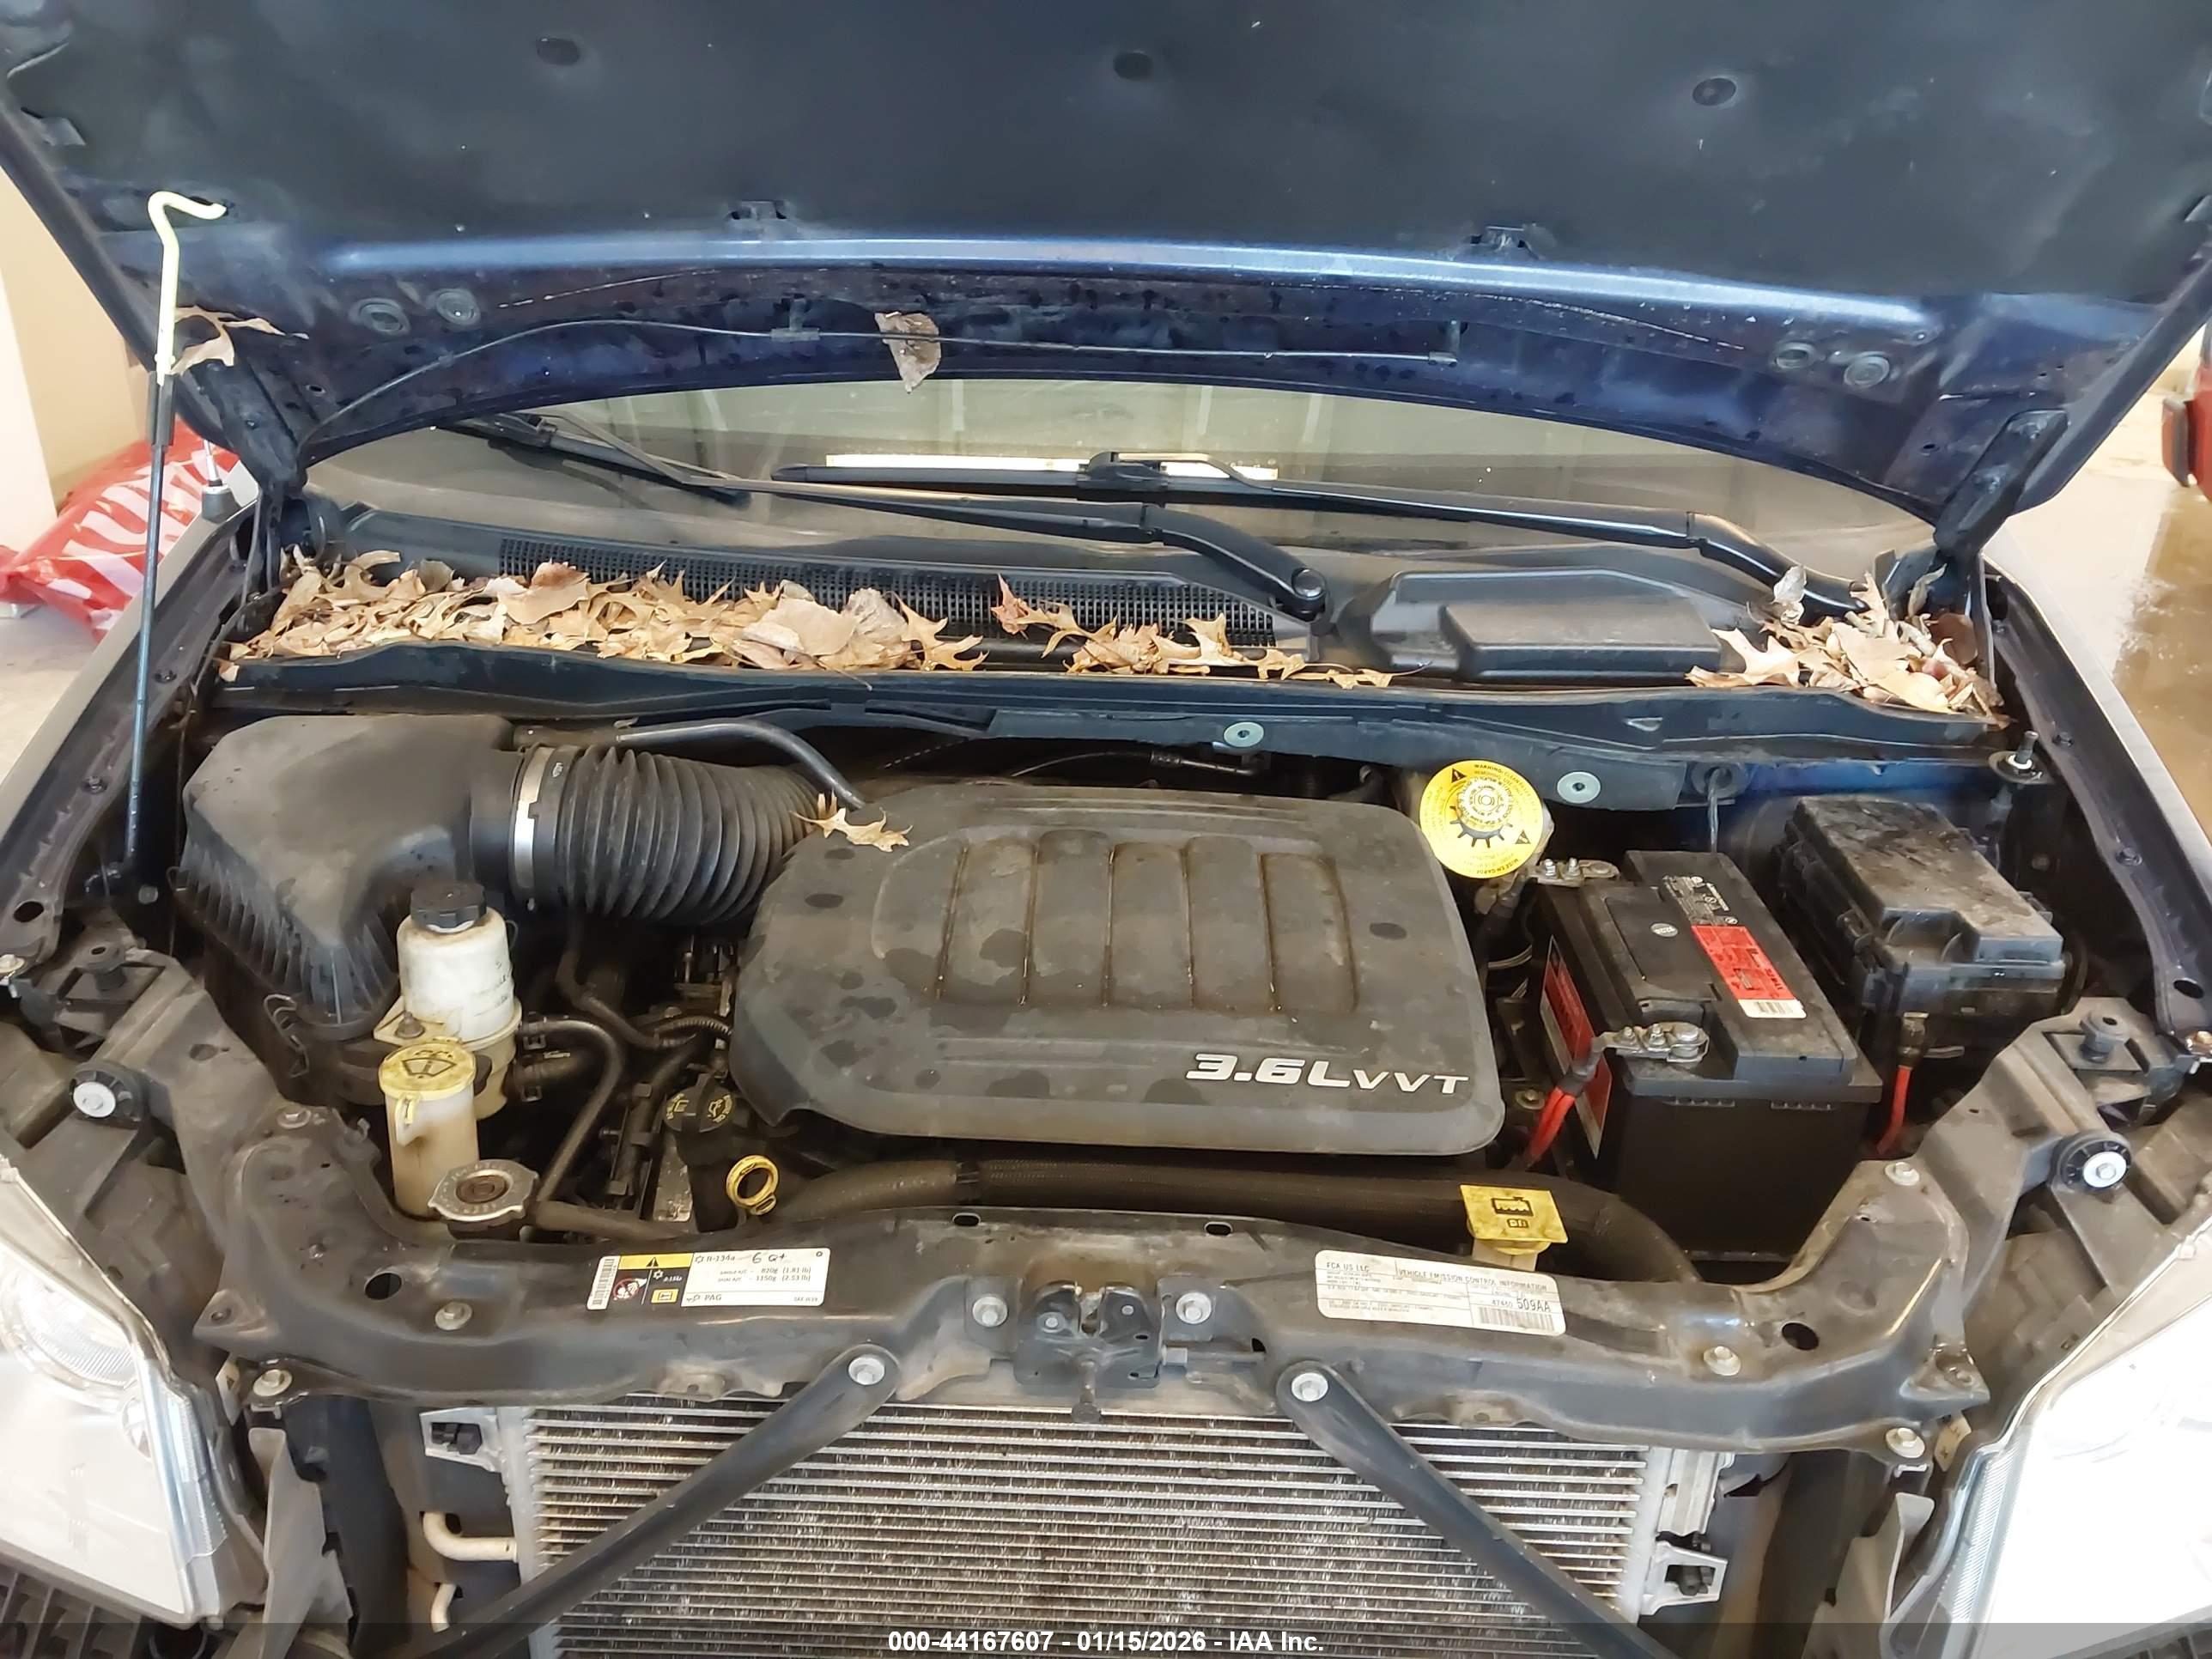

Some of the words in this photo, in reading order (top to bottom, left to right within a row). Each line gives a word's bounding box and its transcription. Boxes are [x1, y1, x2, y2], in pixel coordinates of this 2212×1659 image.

[1186, 1053, 1351, 1088] 3.6L
[1352, 1069, 1469, 1094] VVT
[751, 1252, 763, 1264] 6
[1400, 1269, 1427, 1278] VEHICLE
[1466, 1276, 1496, 1286] CONTROL
[1499, 1279, 1547, 1291] INFORMATION
[1516, 1297, 1551, 1313] 509AA
